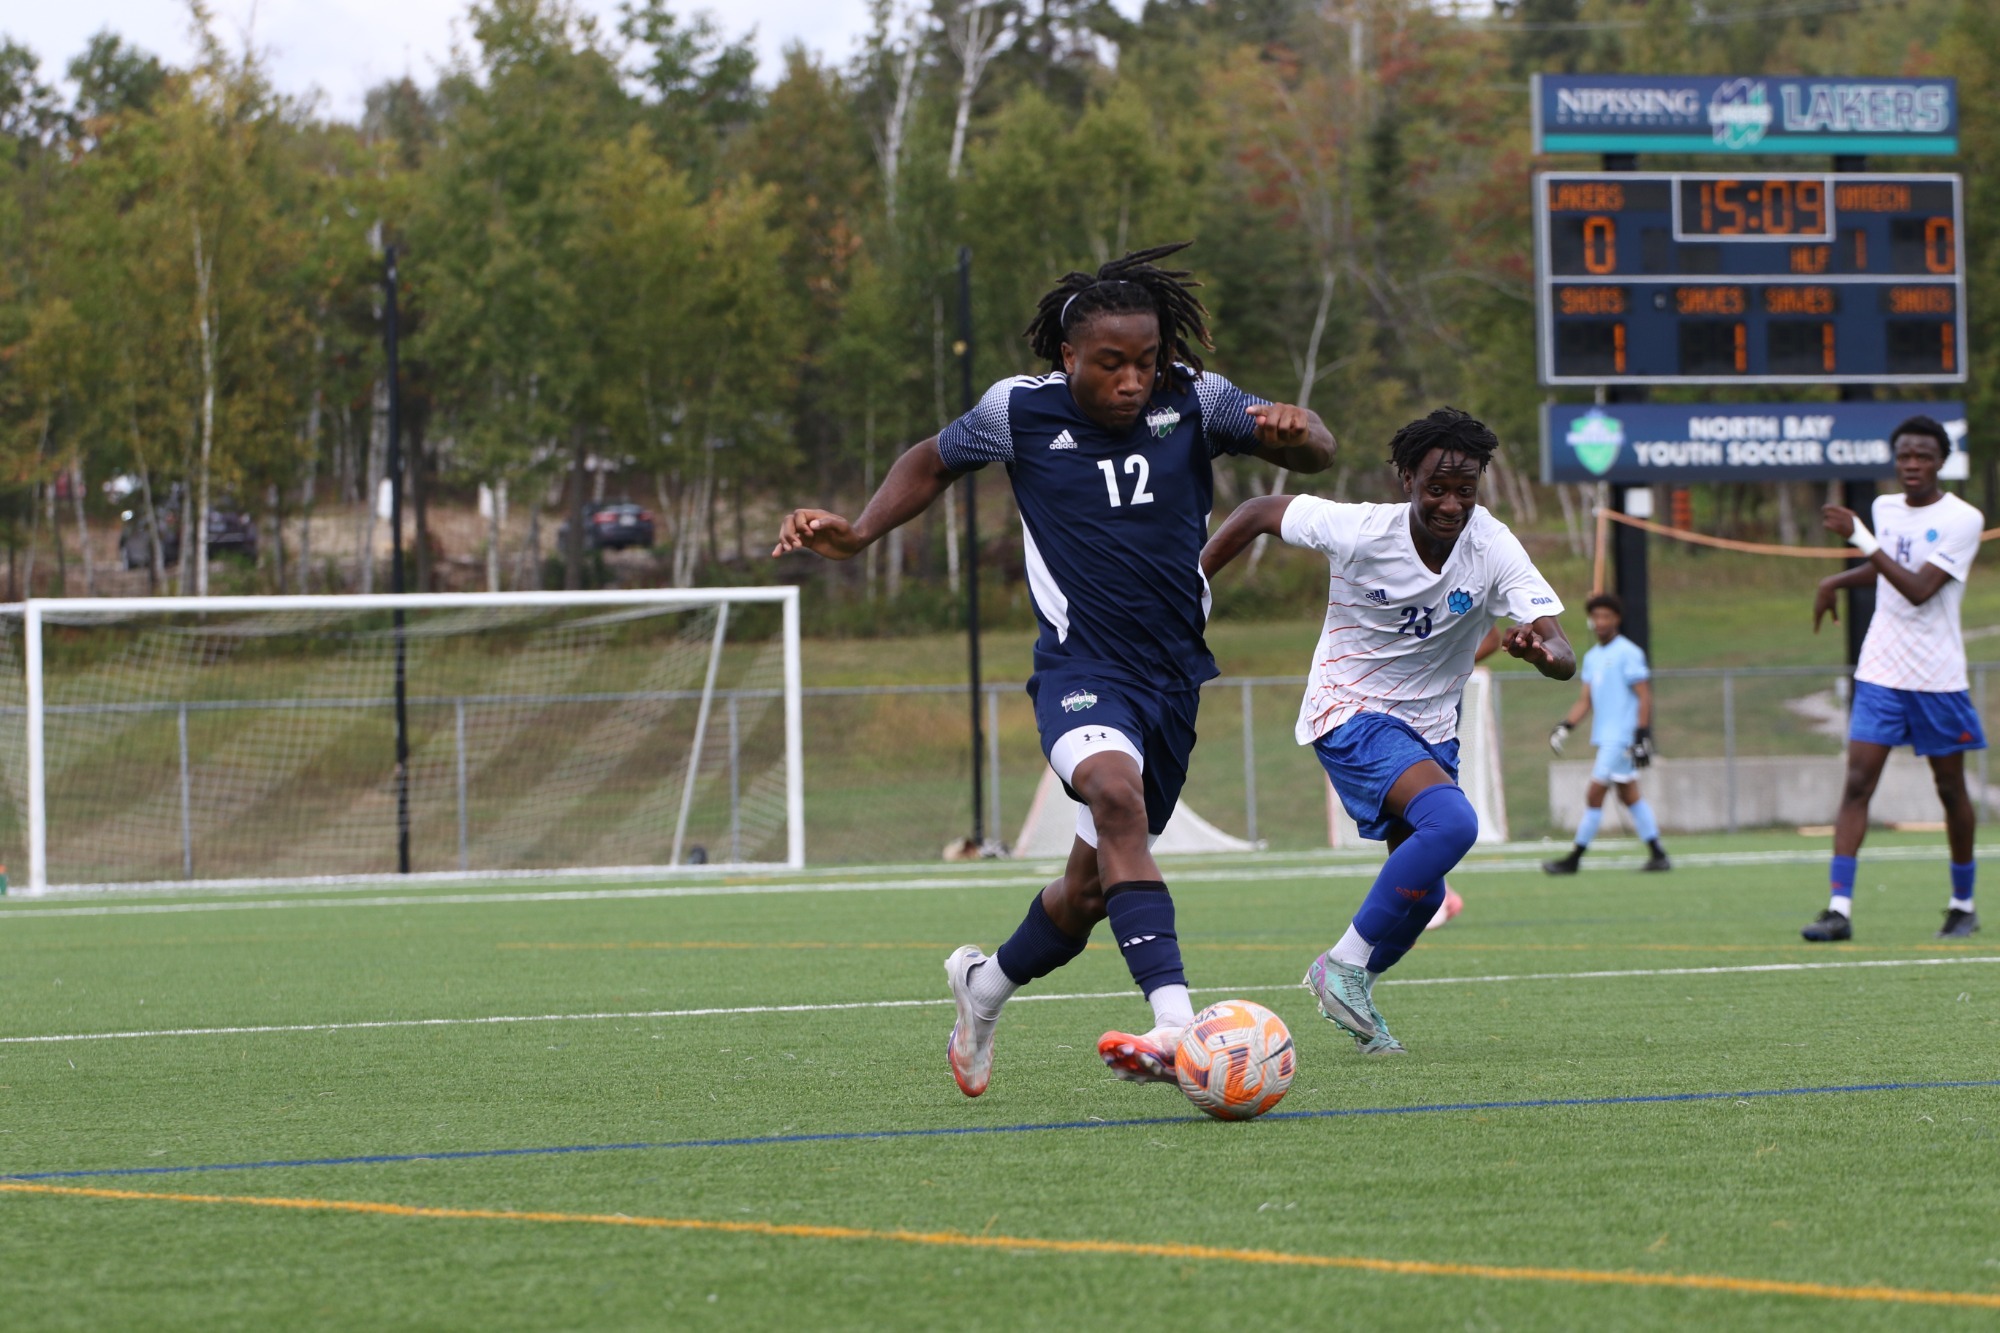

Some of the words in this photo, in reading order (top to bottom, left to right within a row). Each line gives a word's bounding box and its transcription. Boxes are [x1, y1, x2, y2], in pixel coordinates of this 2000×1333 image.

[1557, 88, 1699, 115] NIPISSING
[1780, 84, 1949, 132] LAKERS
[1701, 180, 1825, 235] 15:09
[1584, 215, 1616, 275] 0
[1925, 216, 1955, 275] 0
[1613, 322, 1626, 373] 1
[1734, 322, 1747, 373] 1
[1822, 321, 1836, 372] 1
[1941, 321, 1954, 371] 1
[1145, 412, 1181, 426] LAKERS
[1688, 416, 1780, 440] NORTH
[1783, 415, 1834, 440] BAY
[1049, 442, 1078, 450] adidas
[1632, 441, 1723, 466] YOUTH
[1726, 441, 1824, 466] SOCCER
[1826, 439, 1891, 464] CLUB
[1097, 454, 1154, 507] 12
[1398, 606, 1434, 639] 23
